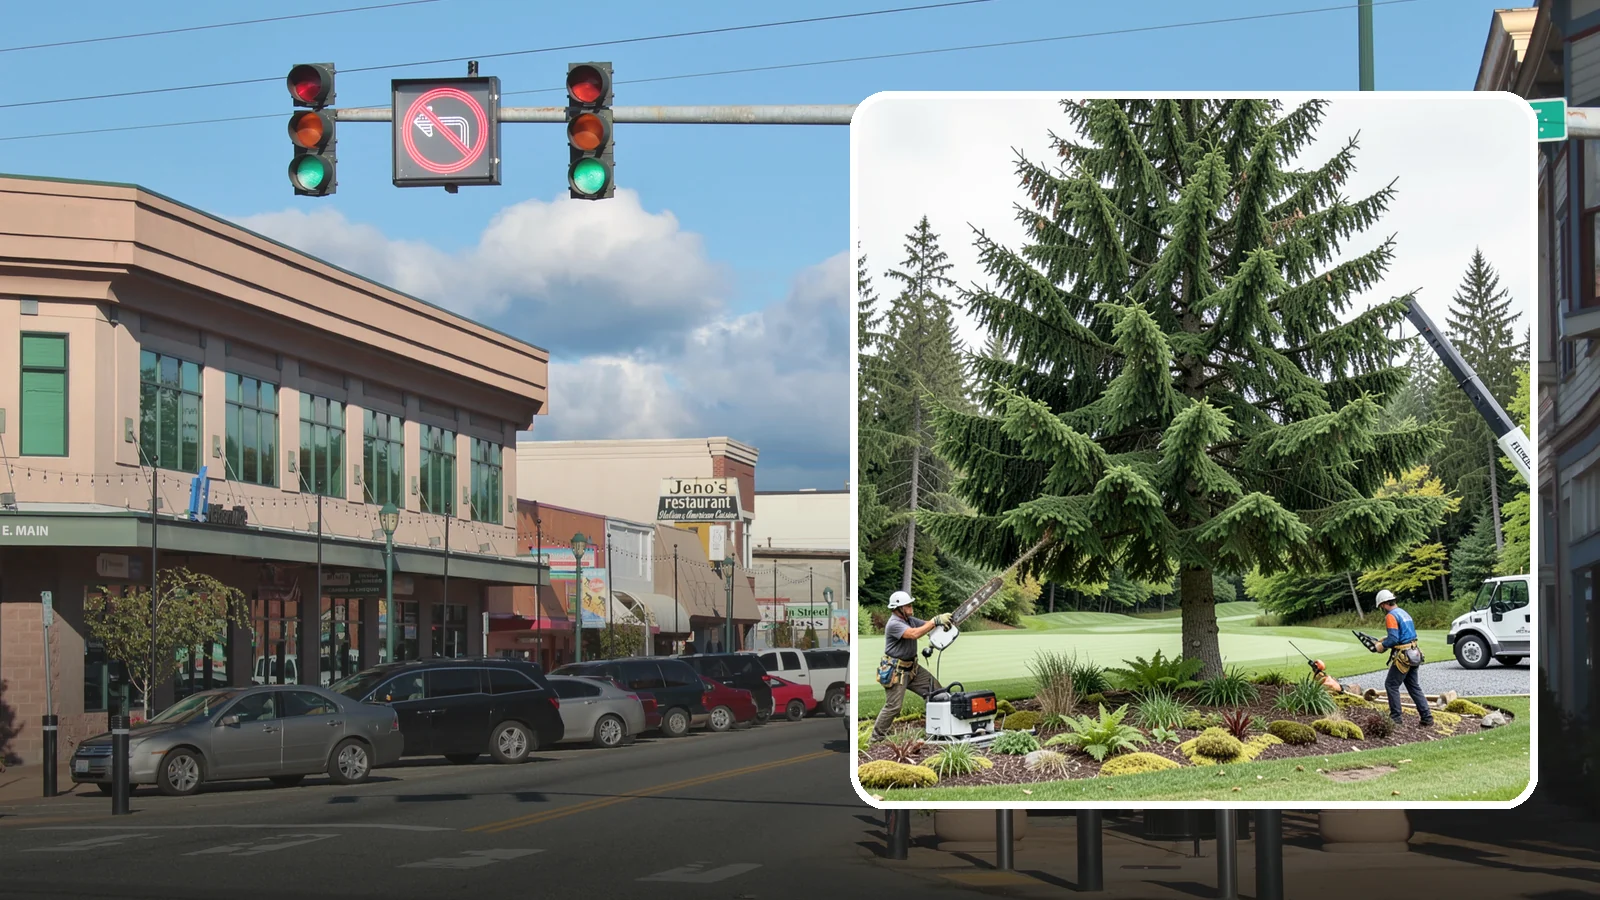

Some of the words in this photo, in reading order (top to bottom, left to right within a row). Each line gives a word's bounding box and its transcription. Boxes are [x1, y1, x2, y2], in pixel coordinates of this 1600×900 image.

[670, 480, 727, 494] Jeno's
[665, 496, 731, 509] restaurant
[659, 510, 681, 520] Italian
[686, 510, 714, 519] American
[715, 509, 737, 519] Cuisine
[2, 525, 12, 536] E.
[15, 525, 49, 536] MAIN
[797, 608, 828, 616] Street
